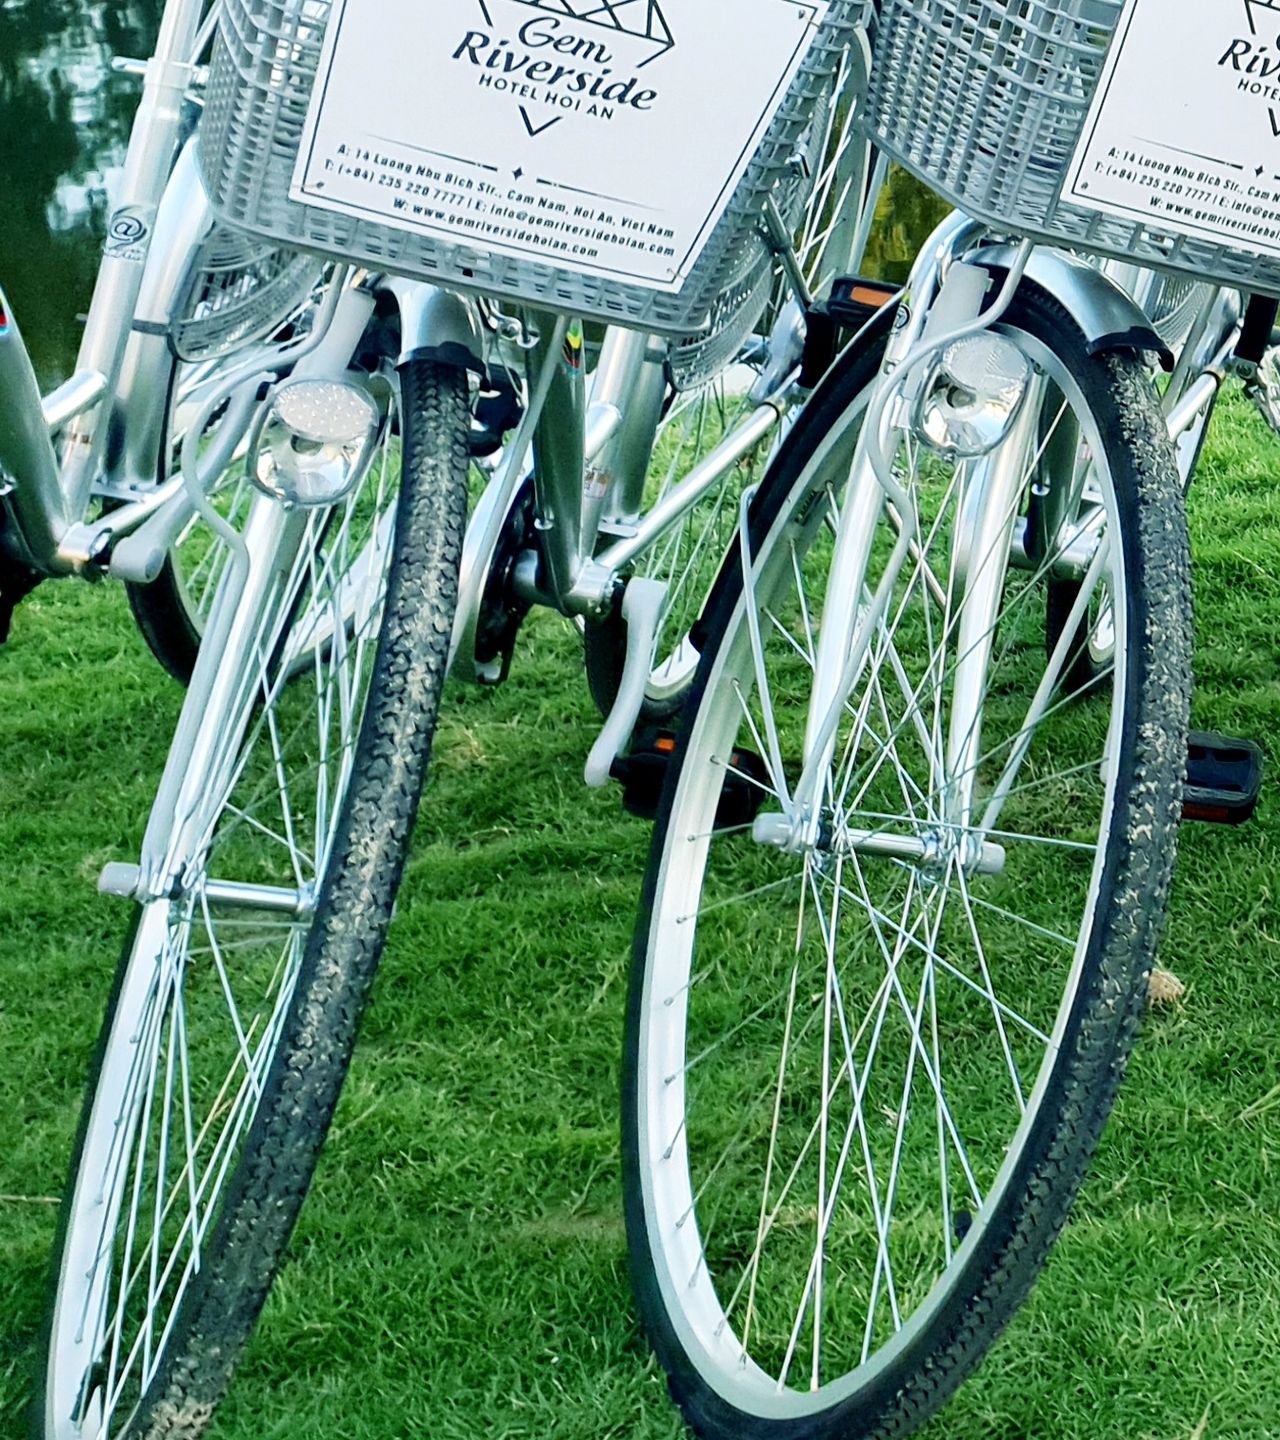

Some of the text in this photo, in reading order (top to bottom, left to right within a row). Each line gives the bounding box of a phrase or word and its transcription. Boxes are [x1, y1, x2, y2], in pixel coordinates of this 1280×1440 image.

[518, 17, 613, 64] Gem
[451, 31, 658, 110] Riverside
[478, 73, 614, 120] HOTEL HOI AN
[337, 163, 375, 183] (+84)
[378, 174, 402, 189] 235
[405, 182, 430, 197] 220
[433, 188, 465, 206] 7777
[355, 148, 370, 161] 14
[373, 153, 413, 174] Luong
[415, 165, 441, 181] Nhu
[444, 173, 474, 190] Bich
[507, 189, 535, 205] Cam
[573, 205, 595, 220] Hoi
[621, 216, 645, 232] Viet
[646, 223, 674, 238] Nam
[1105, 165, 1138, 183] (+84)
[1138, 174, 1161, 189] 235
[1161, 180, 1183, 195] 220
[1184, 186, 1212, 203] 7777
[1122, 150, 1136, 163] 14
[1138, 155, 1171, 174] Luong
[1172, 165, 1195, 180] Nhu
[1196, 171, 1221, 187] Bich
[1247, 185, 1270, 200] Cam
